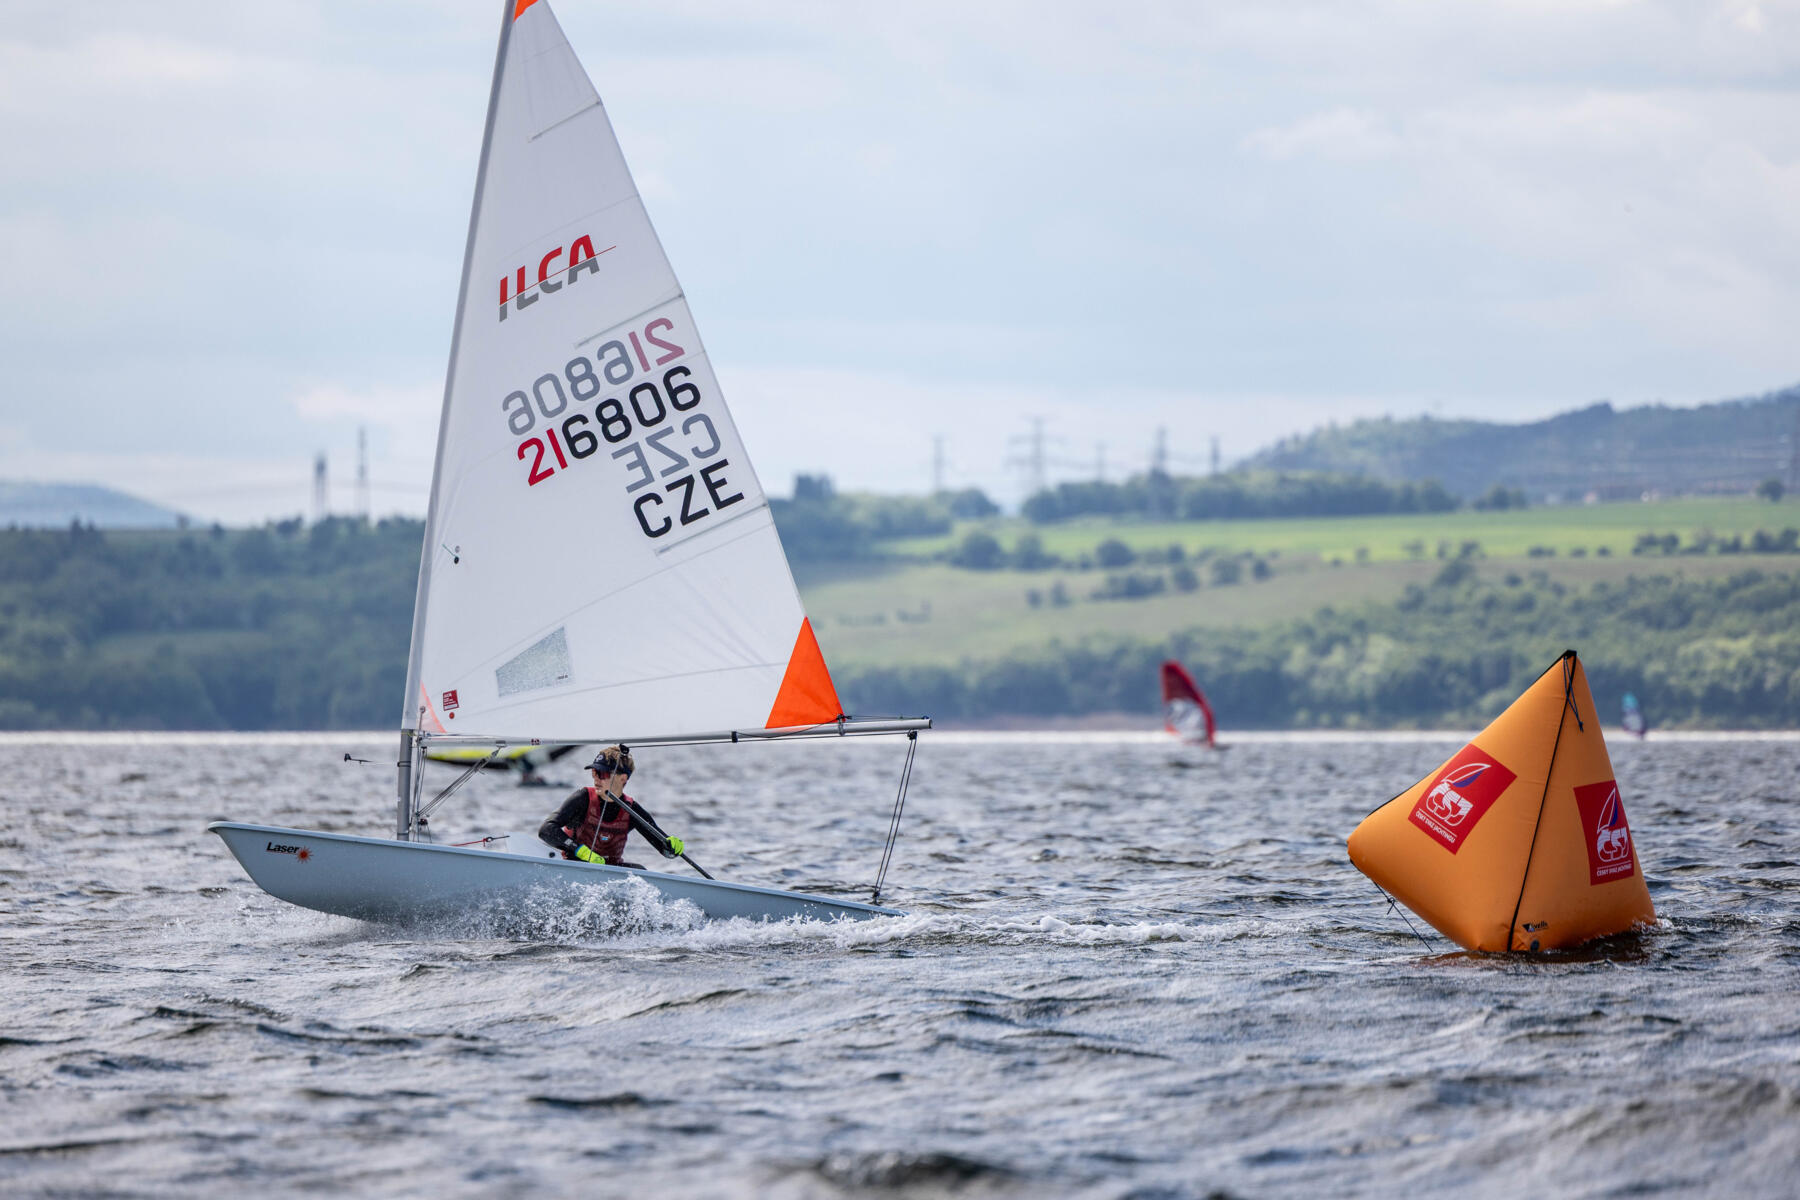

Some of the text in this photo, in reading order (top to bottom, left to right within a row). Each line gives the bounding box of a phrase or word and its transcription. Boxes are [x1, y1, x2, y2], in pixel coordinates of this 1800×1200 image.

[499, 234, 600, 322] ILCA
[517, 366, 701, 487] 216806
[633, 458, 745, 539] CZE
[267, 841, 300, 854] Laser
